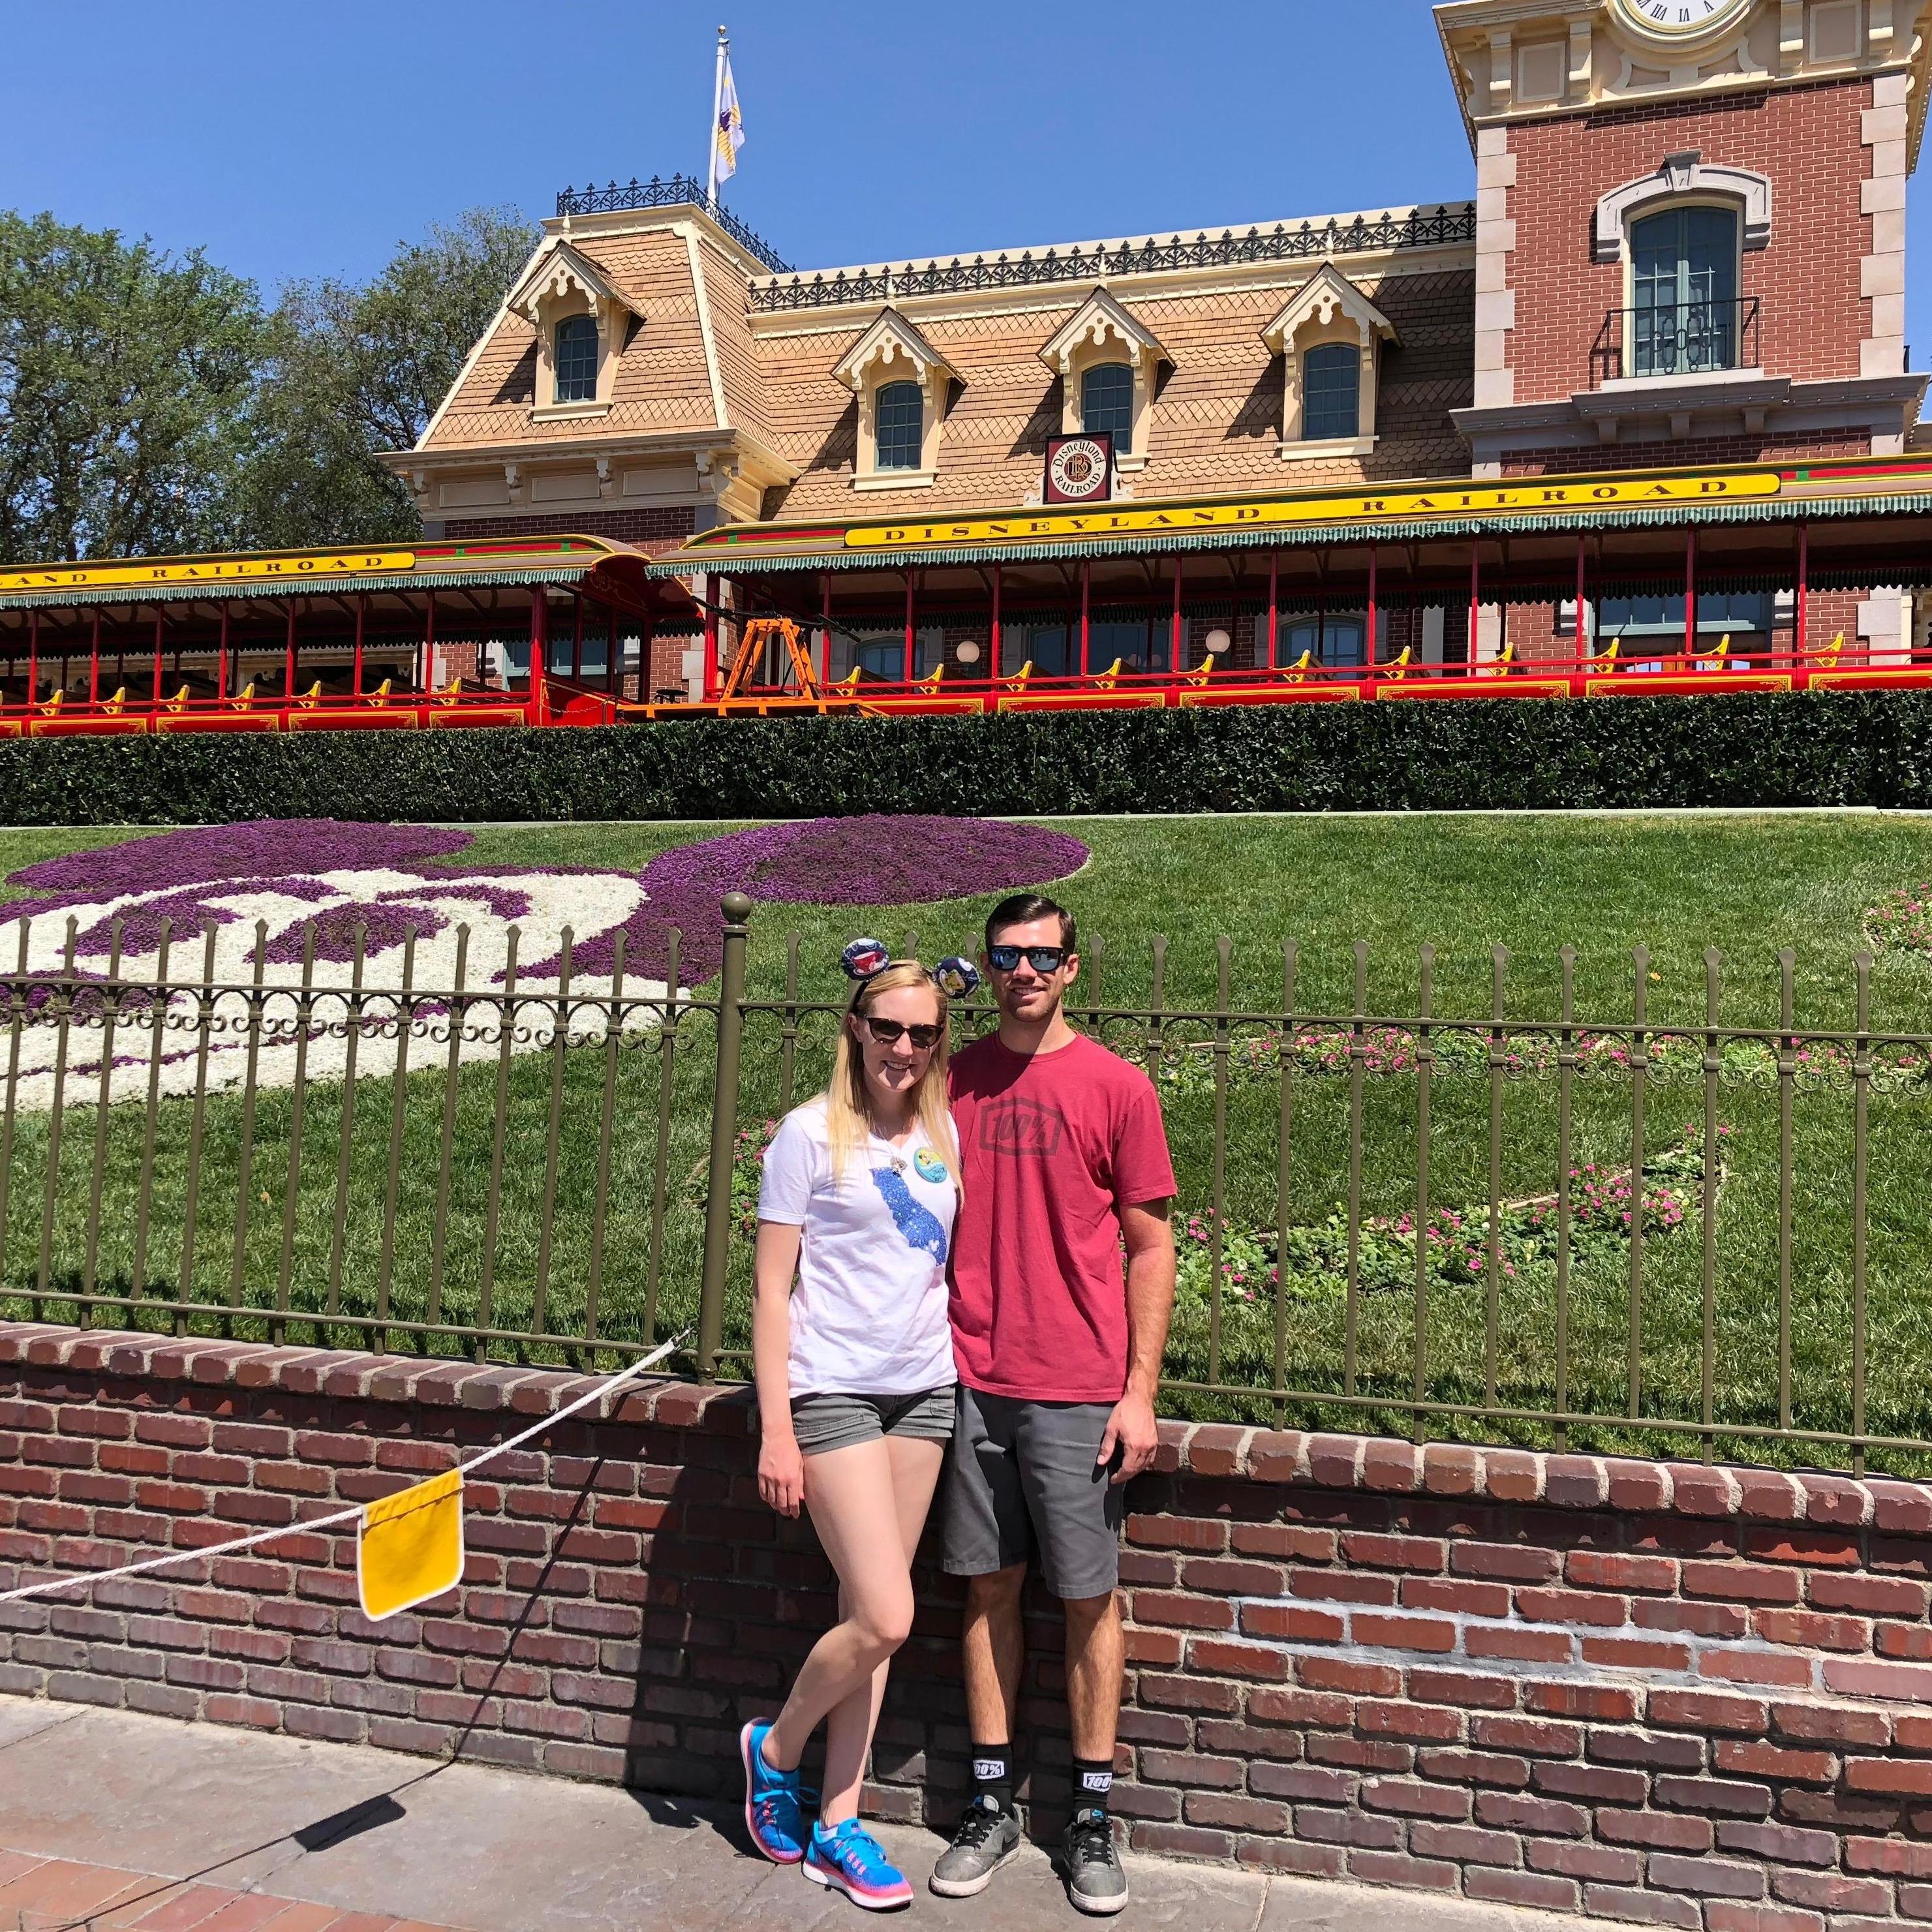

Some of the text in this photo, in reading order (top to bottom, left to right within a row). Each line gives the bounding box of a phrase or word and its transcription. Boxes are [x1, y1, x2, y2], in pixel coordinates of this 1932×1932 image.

[1678, 7, 1691, 22] VI
[1052, 441, 1105, 468] Disneyland
[1055, 472, 1101, 494] RAILROAD
[883, 482, 1728, 541] DISNEYLAND RAILROAD
[0, 557, 382, 586] AND RAILROAD
[1087, 1775, 1111, 1788] 100
